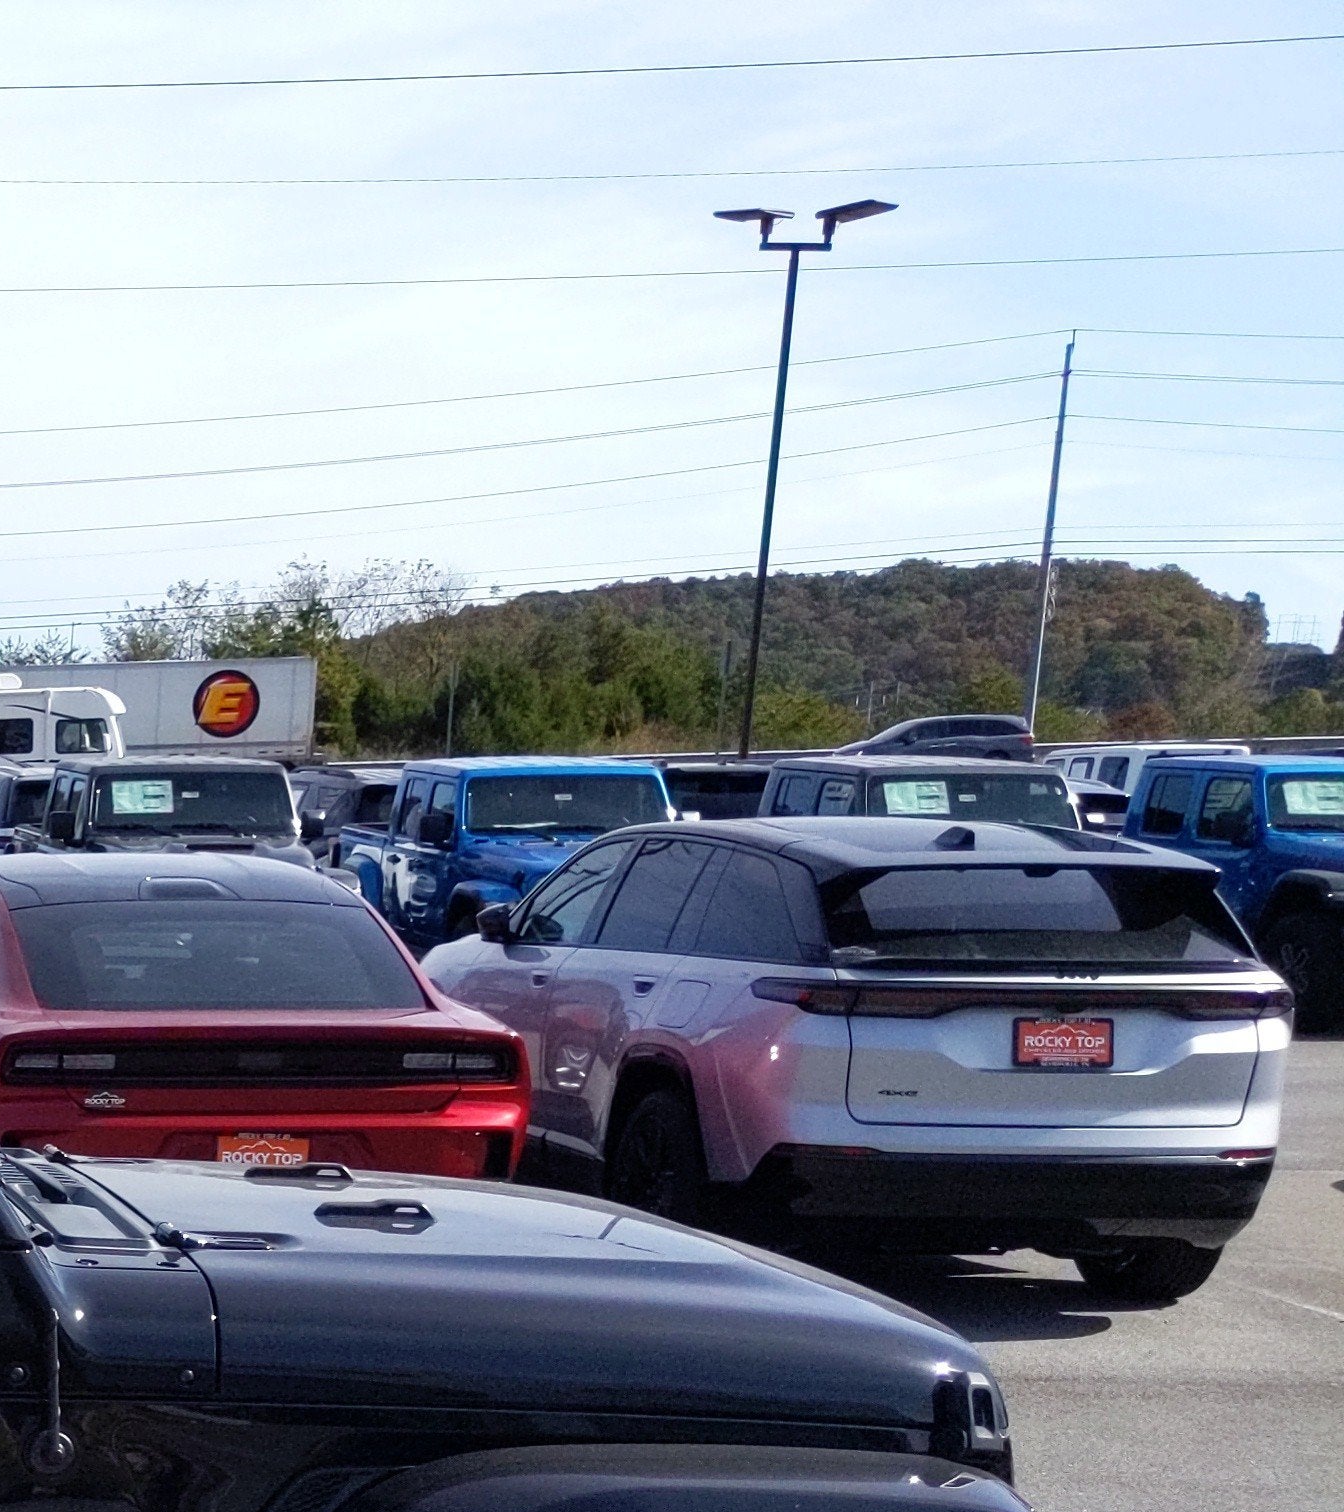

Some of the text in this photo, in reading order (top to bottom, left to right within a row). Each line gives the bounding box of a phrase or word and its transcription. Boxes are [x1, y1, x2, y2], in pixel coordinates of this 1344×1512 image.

[197, 682, 251, 725] E
[1024, 1035, 1106, 1048] ROCKY TOP
[84, 1097, 126, 1105] ROCKY TOP
[221, 1151, 304, 1166] ROCKY TOP
